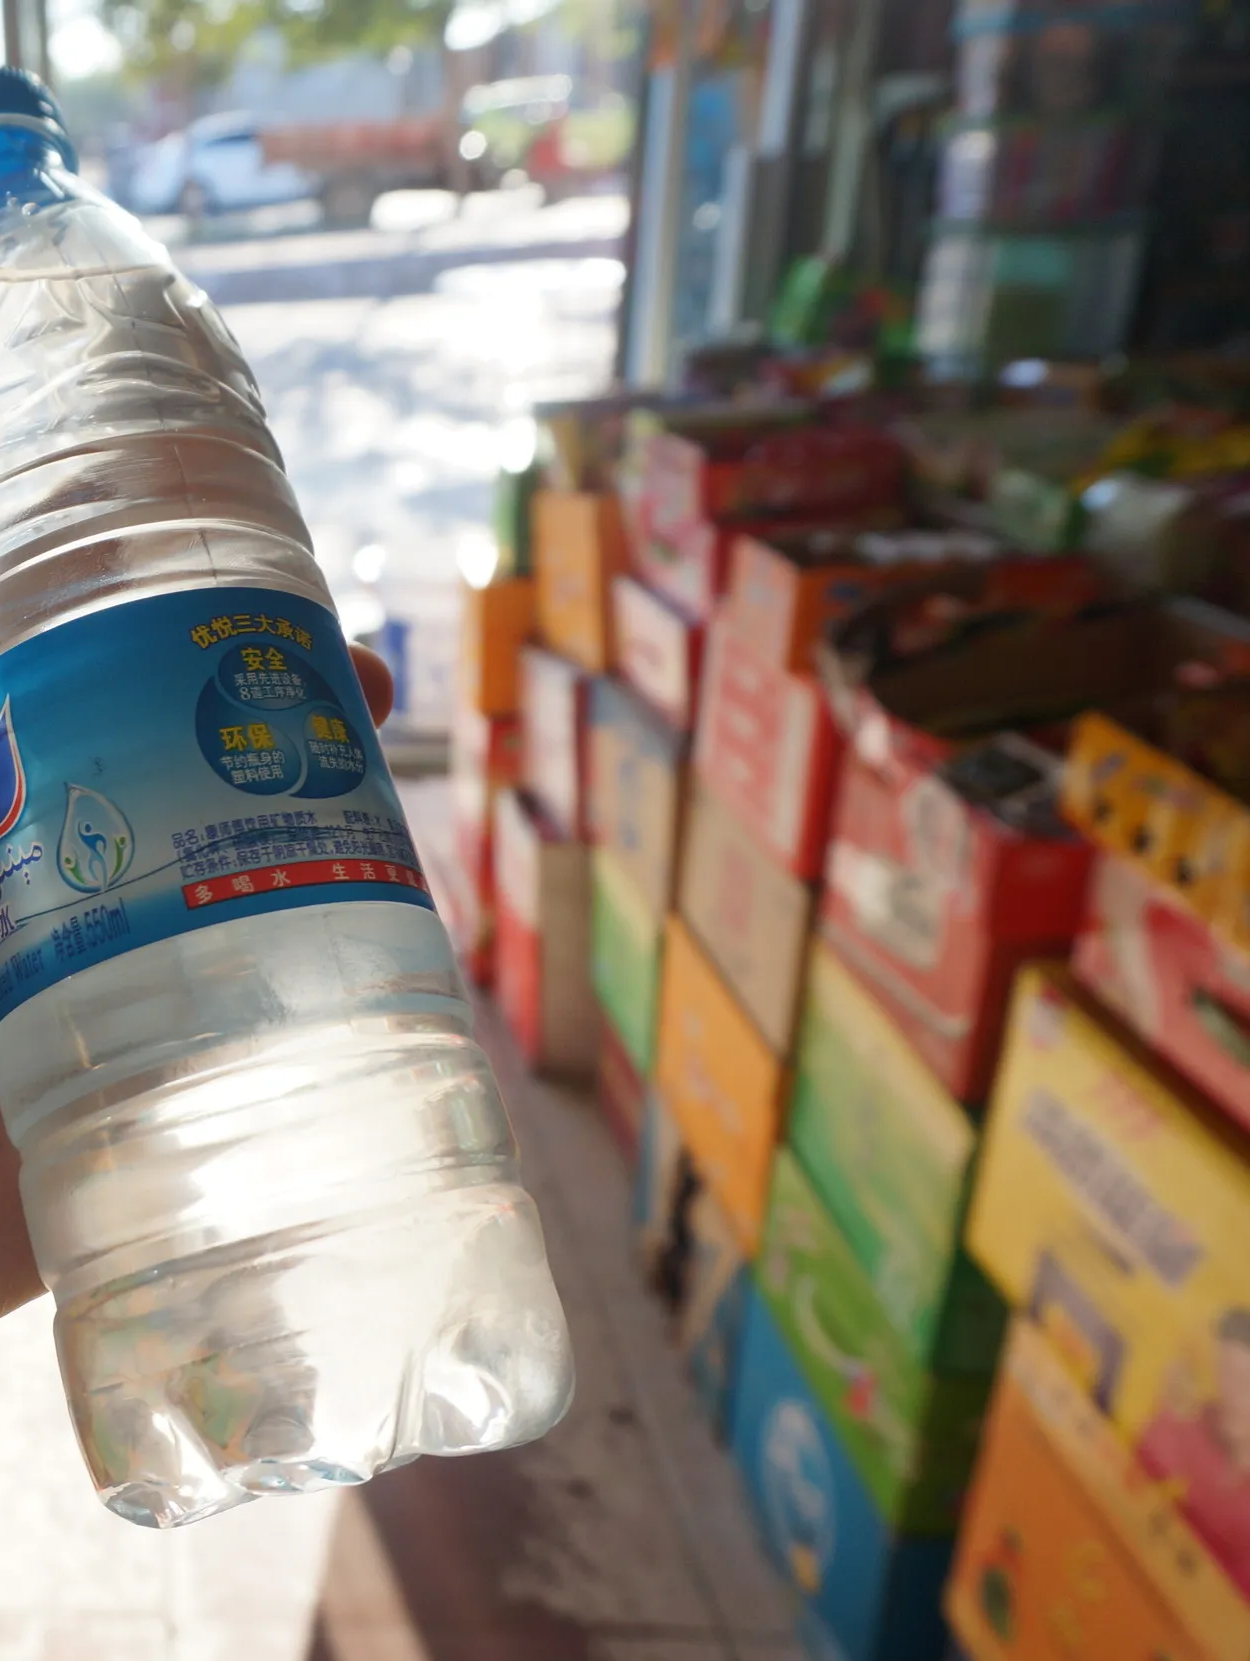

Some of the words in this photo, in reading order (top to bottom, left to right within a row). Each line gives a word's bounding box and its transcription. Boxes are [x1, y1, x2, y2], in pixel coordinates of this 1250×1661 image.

[190, 613, 313, 651] 优悦三大承诺
[240, 647, 288, 671] 安全
[218, 722, 275, 752] 环保
[221, 750, 286, 770] 节约瓶身的
[230, 765, 285, 786] 塑料使用
